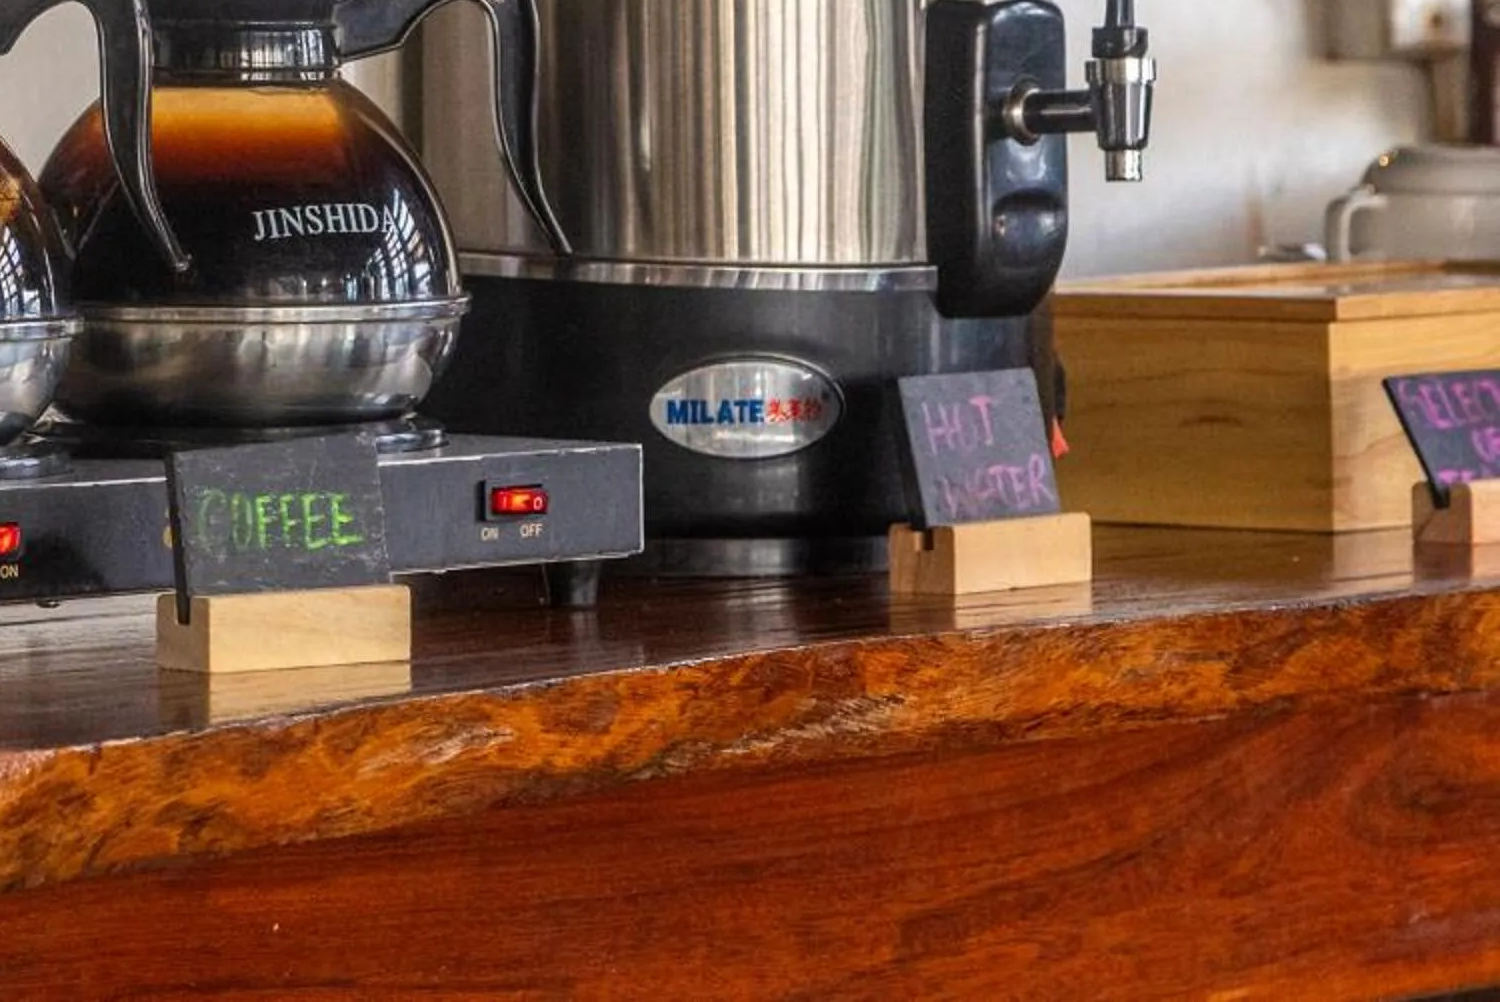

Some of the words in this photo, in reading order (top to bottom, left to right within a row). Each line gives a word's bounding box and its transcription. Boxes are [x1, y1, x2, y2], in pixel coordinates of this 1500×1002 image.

[252, 202, 399, 241] JINSHIDA
[666, 399, 765, 425] MILATE
[198, 489, 366, 551] COFFEE
[481, 526, 499, 541] ON
[520, 522, 544, 538] OFF
[0, 564, 19, 579] ON
